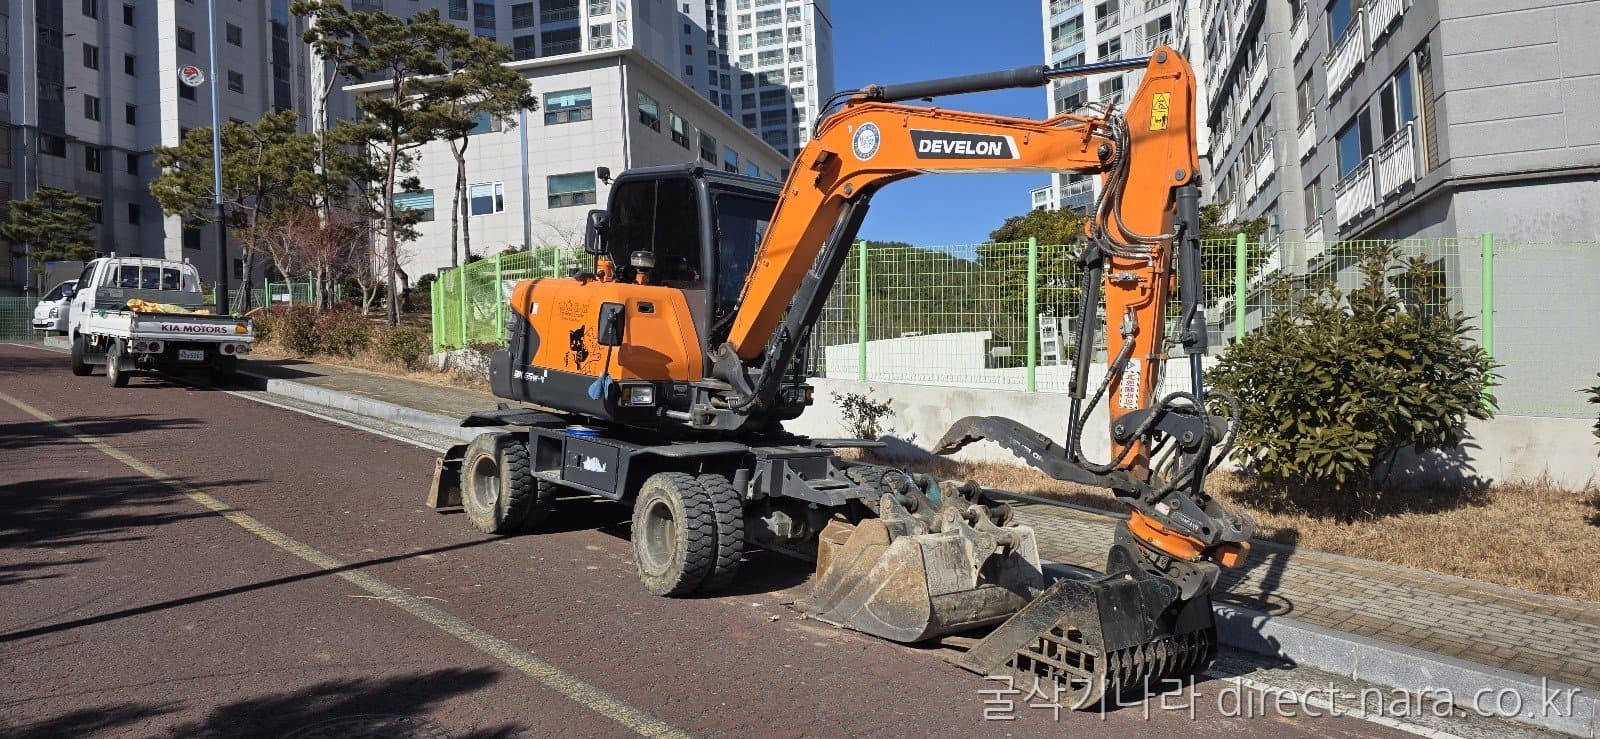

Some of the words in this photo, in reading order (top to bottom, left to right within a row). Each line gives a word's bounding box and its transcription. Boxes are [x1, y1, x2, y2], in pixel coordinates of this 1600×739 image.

[918, 139, 1002, 156] DEVELON
[161, 324, 180, 332] KIA
[183, 325, 228, 334] MOTORS
